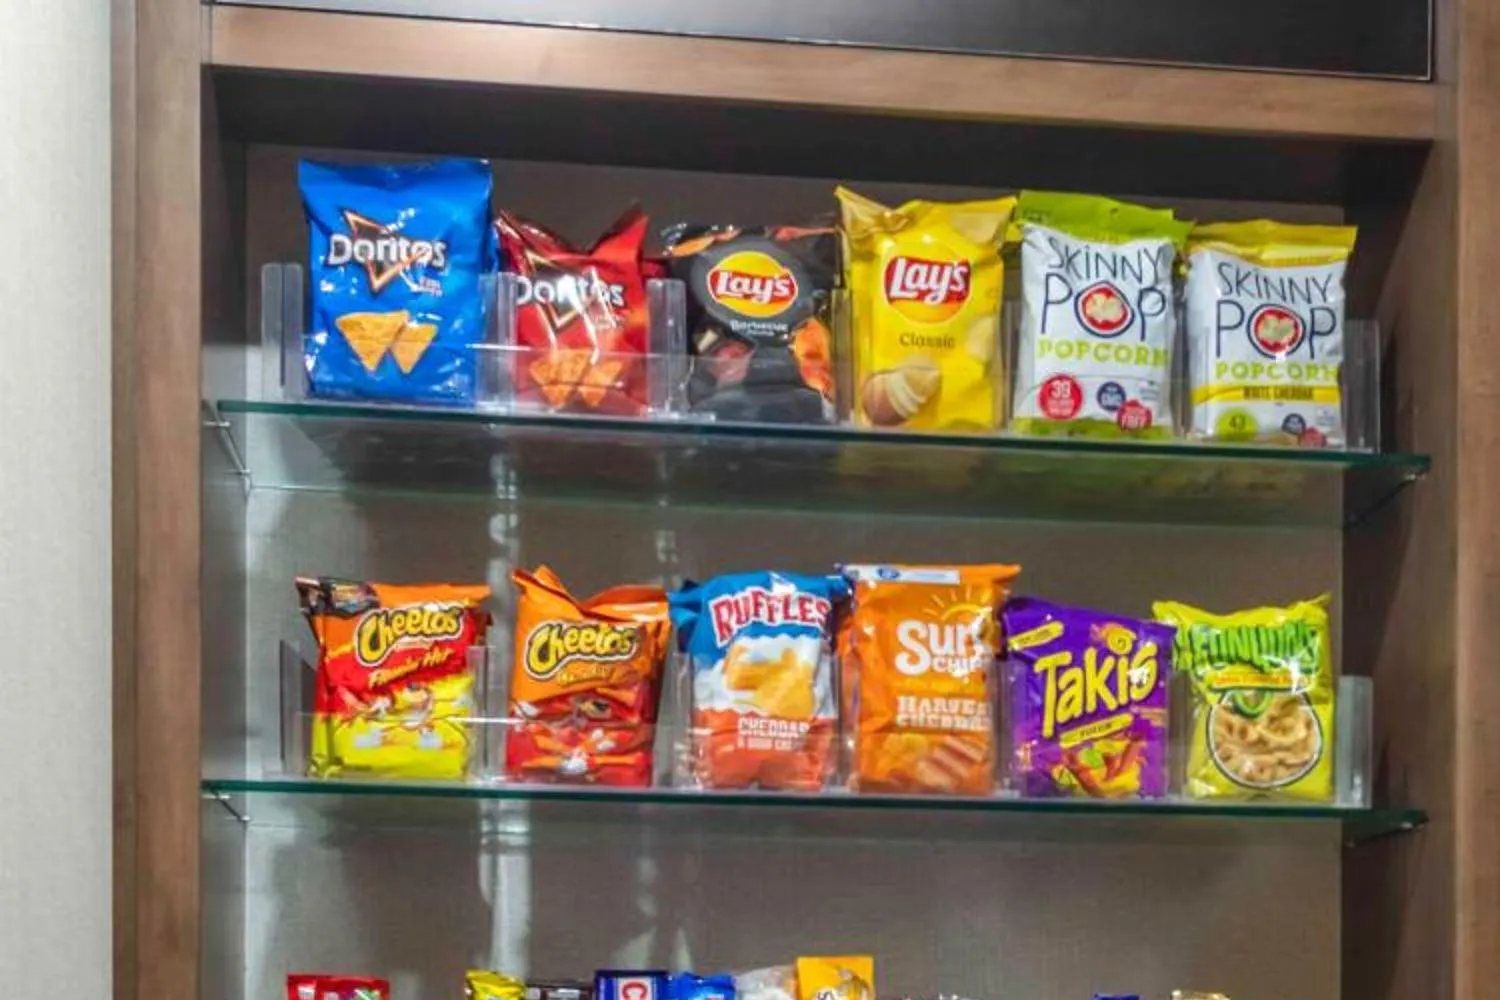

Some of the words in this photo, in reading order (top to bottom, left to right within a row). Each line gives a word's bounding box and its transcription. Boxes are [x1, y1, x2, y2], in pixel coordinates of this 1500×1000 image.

[327, 233, 448, 268] Doritos
[1047, 236, 1165, 285] SKINNY
[715, 271, 791, 305] Lay's
[889, 256, 968, 305] Lay's
[1217, 261, 1332, 305] SKINNY
[1041, 271, 1167, 341] POP
[1215, 299, 1337, 360] POP
[899, 331, 956, 349] Classic
[1037, 338, 1168, 367] POPCORN
[358, 607, 464, 664] Cheetos
[711, 586, 832, 648] RUFFLES
[527, 624, 638, 679] Cheetos
[1033, 642, 1159, 738] Takis
